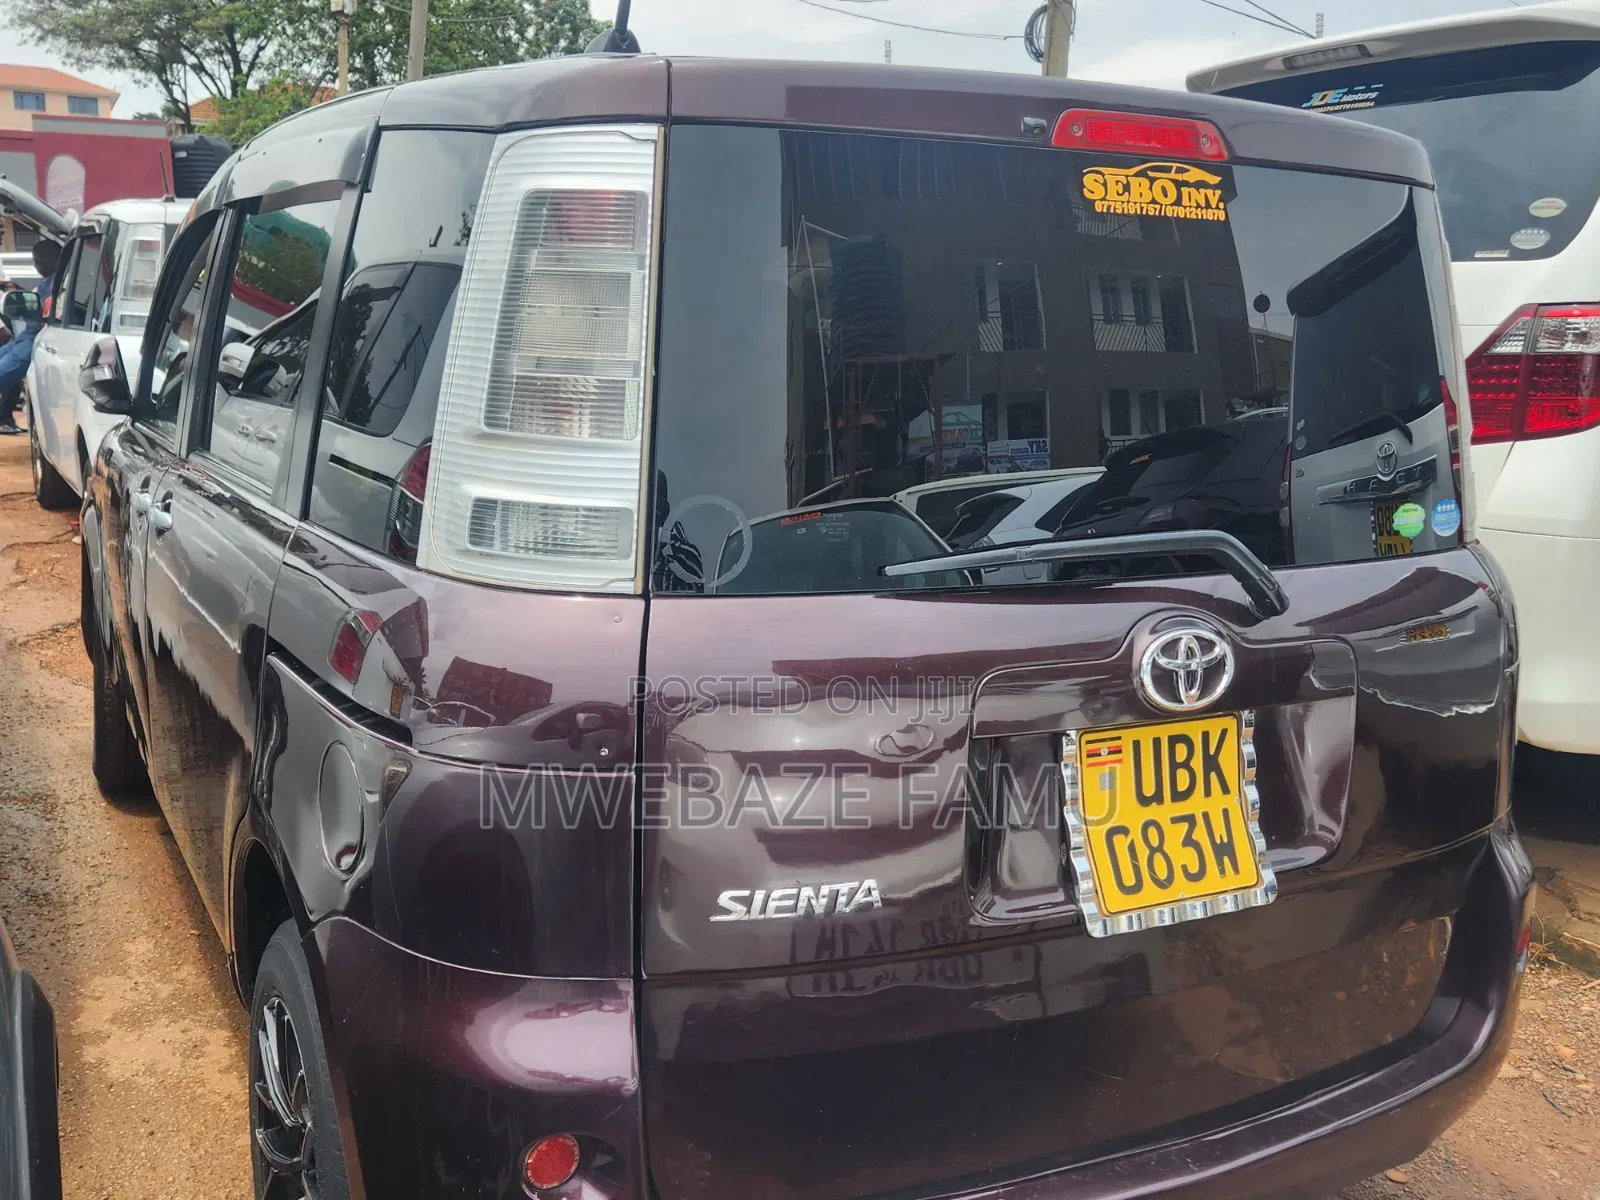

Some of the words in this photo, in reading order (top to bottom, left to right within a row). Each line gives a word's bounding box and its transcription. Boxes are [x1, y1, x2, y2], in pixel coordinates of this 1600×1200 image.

[1301, 88, 1349, 107] JOE
[1340, 92, 1379, 102] Motors
[1083, 173, 1177, 205] SEBO
[1181, 187, 1225, 209] INV.
[1094, 200, 1226, 221] 0775191757/0701211870
[1131, 727, 1231, 808] UBK
[1104, 807, 1240, 896] 083W
[709, 878, 882, 922] SIENTA
